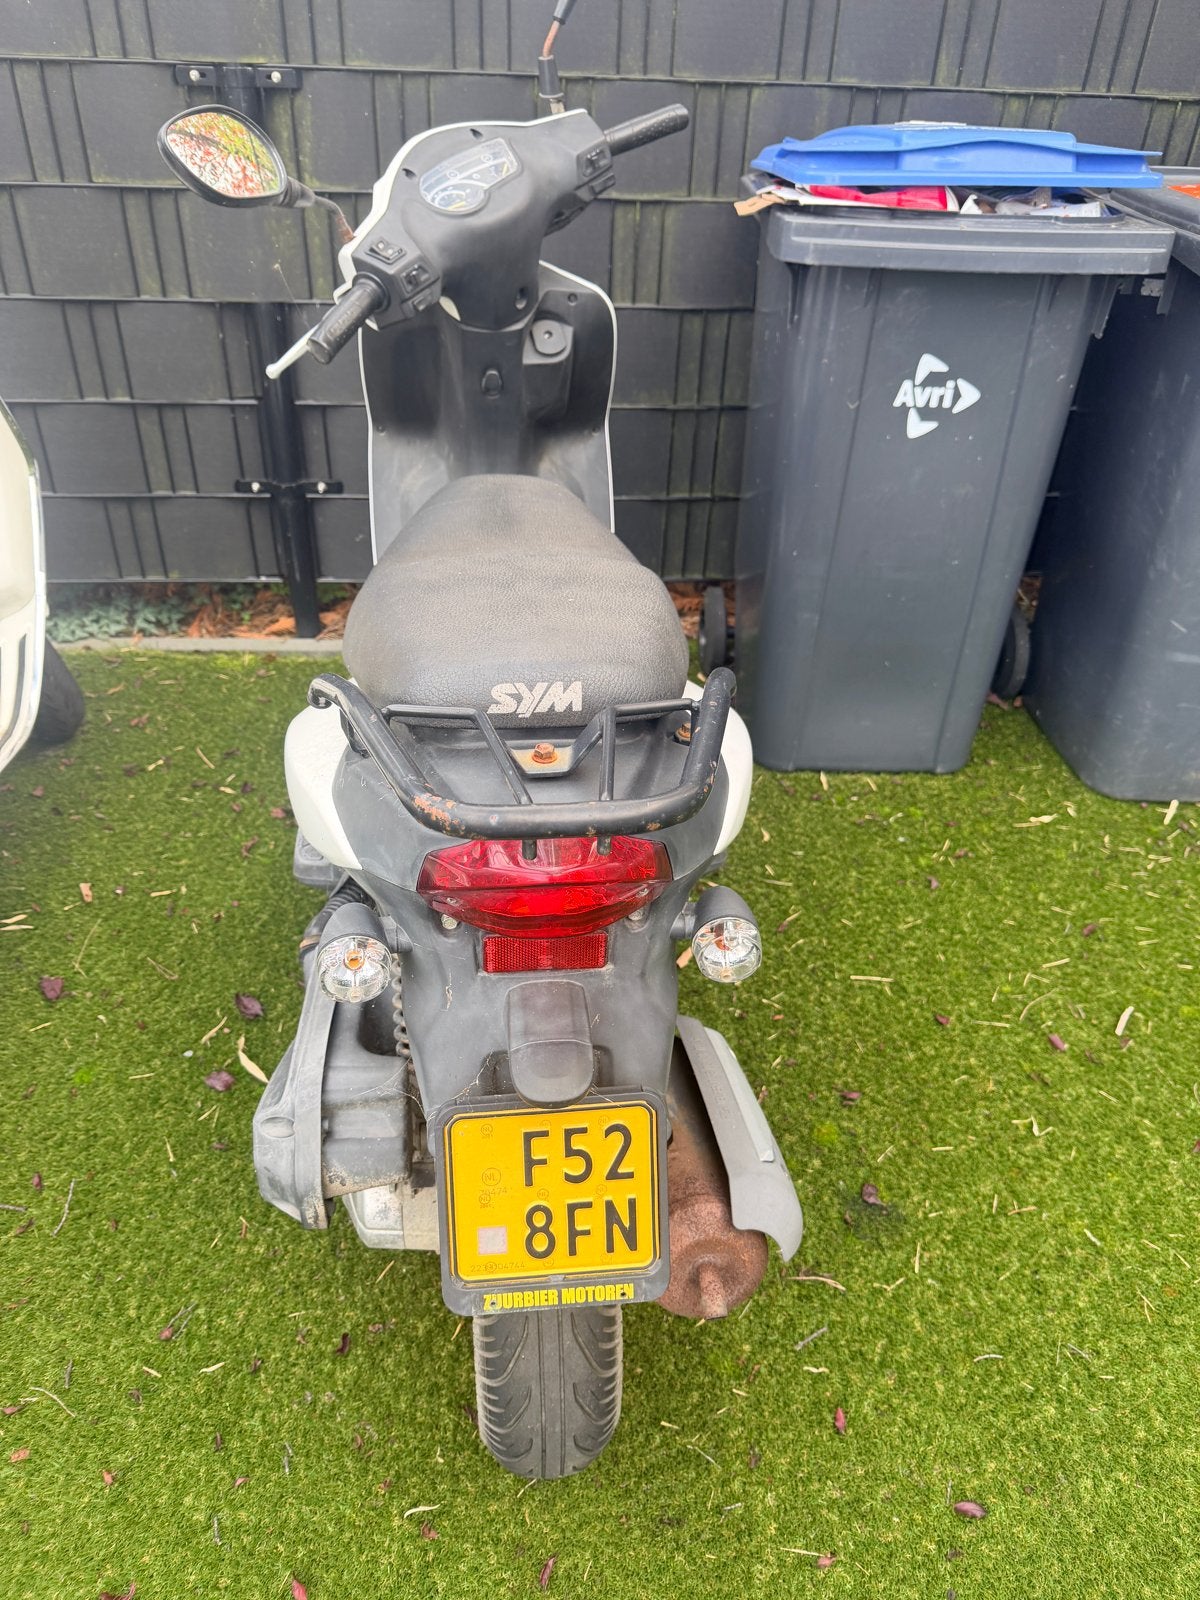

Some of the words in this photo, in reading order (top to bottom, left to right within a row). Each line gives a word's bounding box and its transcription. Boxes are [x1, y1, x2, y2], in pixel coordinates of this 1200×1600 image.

[892, 379, 956, 408] Avri
[487, 681, 582, 718] SYM
[522, 1123, 635, 1187] F52
[524, 1197, 637, 1259] 8FN
[561, 1283, 634, 1305] MOTOREN
